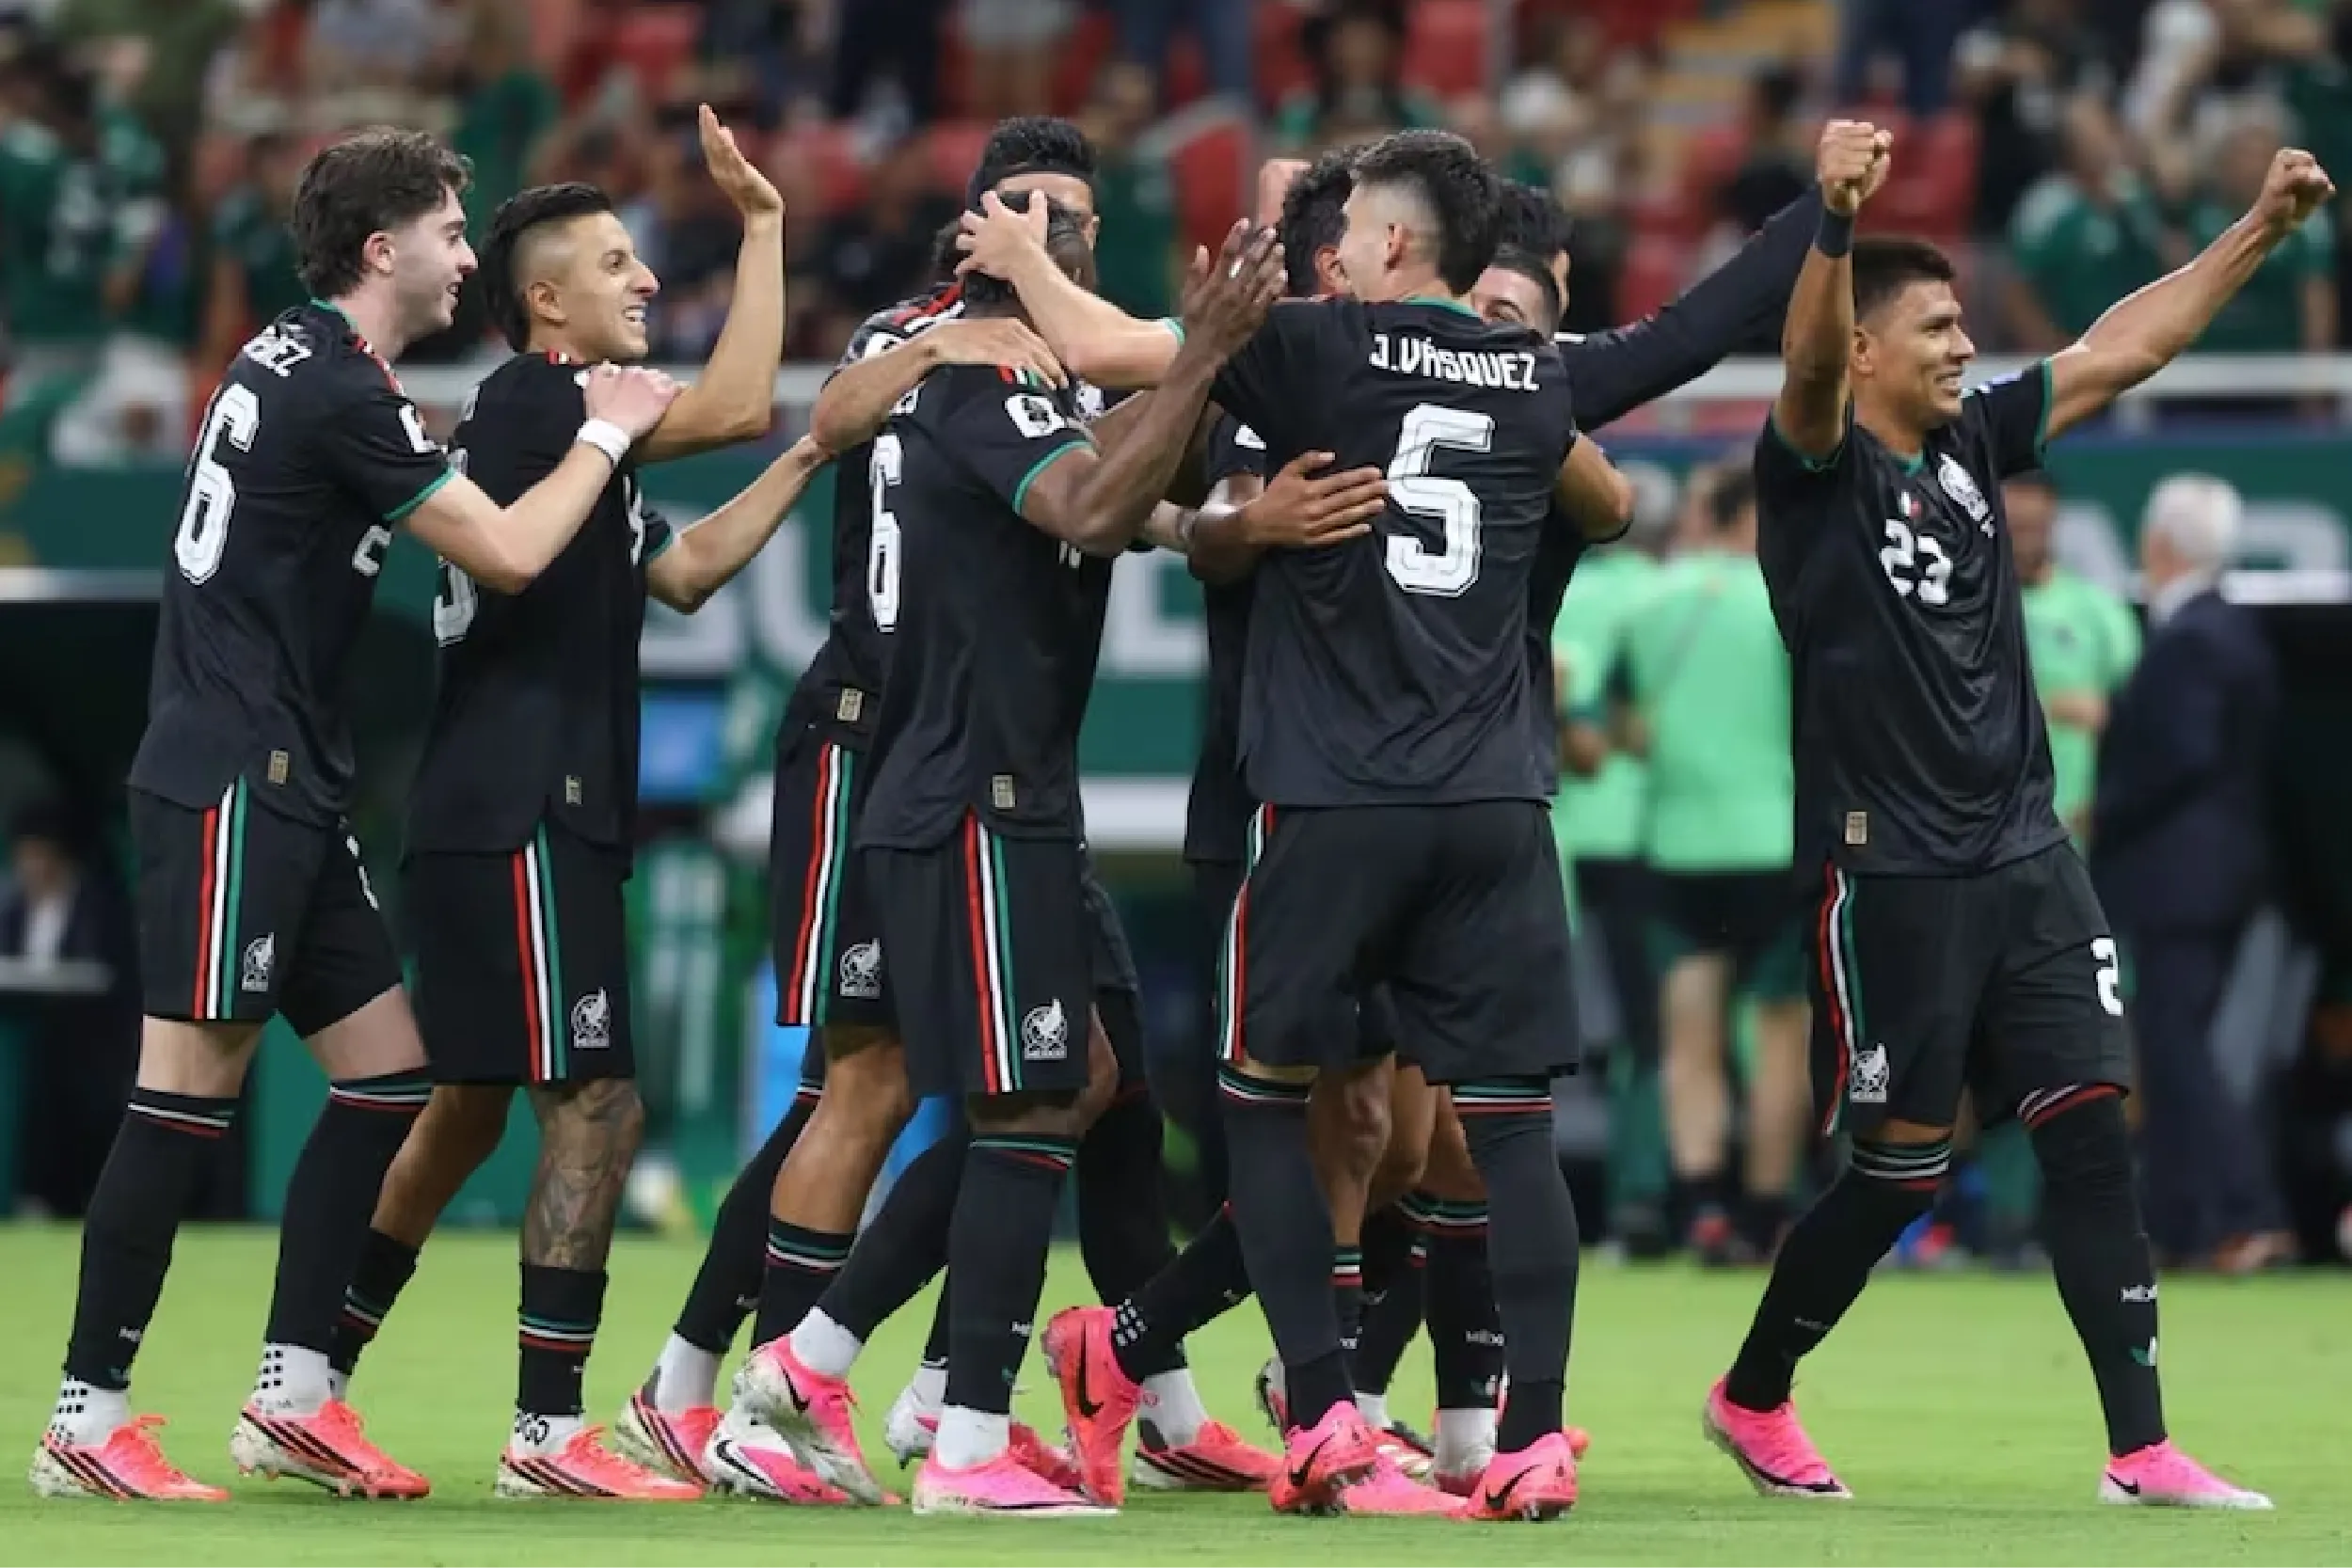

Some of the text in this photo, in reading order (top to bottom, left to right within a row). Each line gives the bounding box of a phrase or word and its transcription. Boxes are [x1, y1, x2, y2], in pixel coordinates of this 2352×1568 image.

[1369, 333, 1541, 391] J.VÁSQUEZ
[175, 380, 261, 586] 6
[867, 433, 904, 634] 6
[1385, 402, 1496, 597] 5
[1878, 518, 1954, 604] 23
[2090, 937, 2125, 1017] 2
